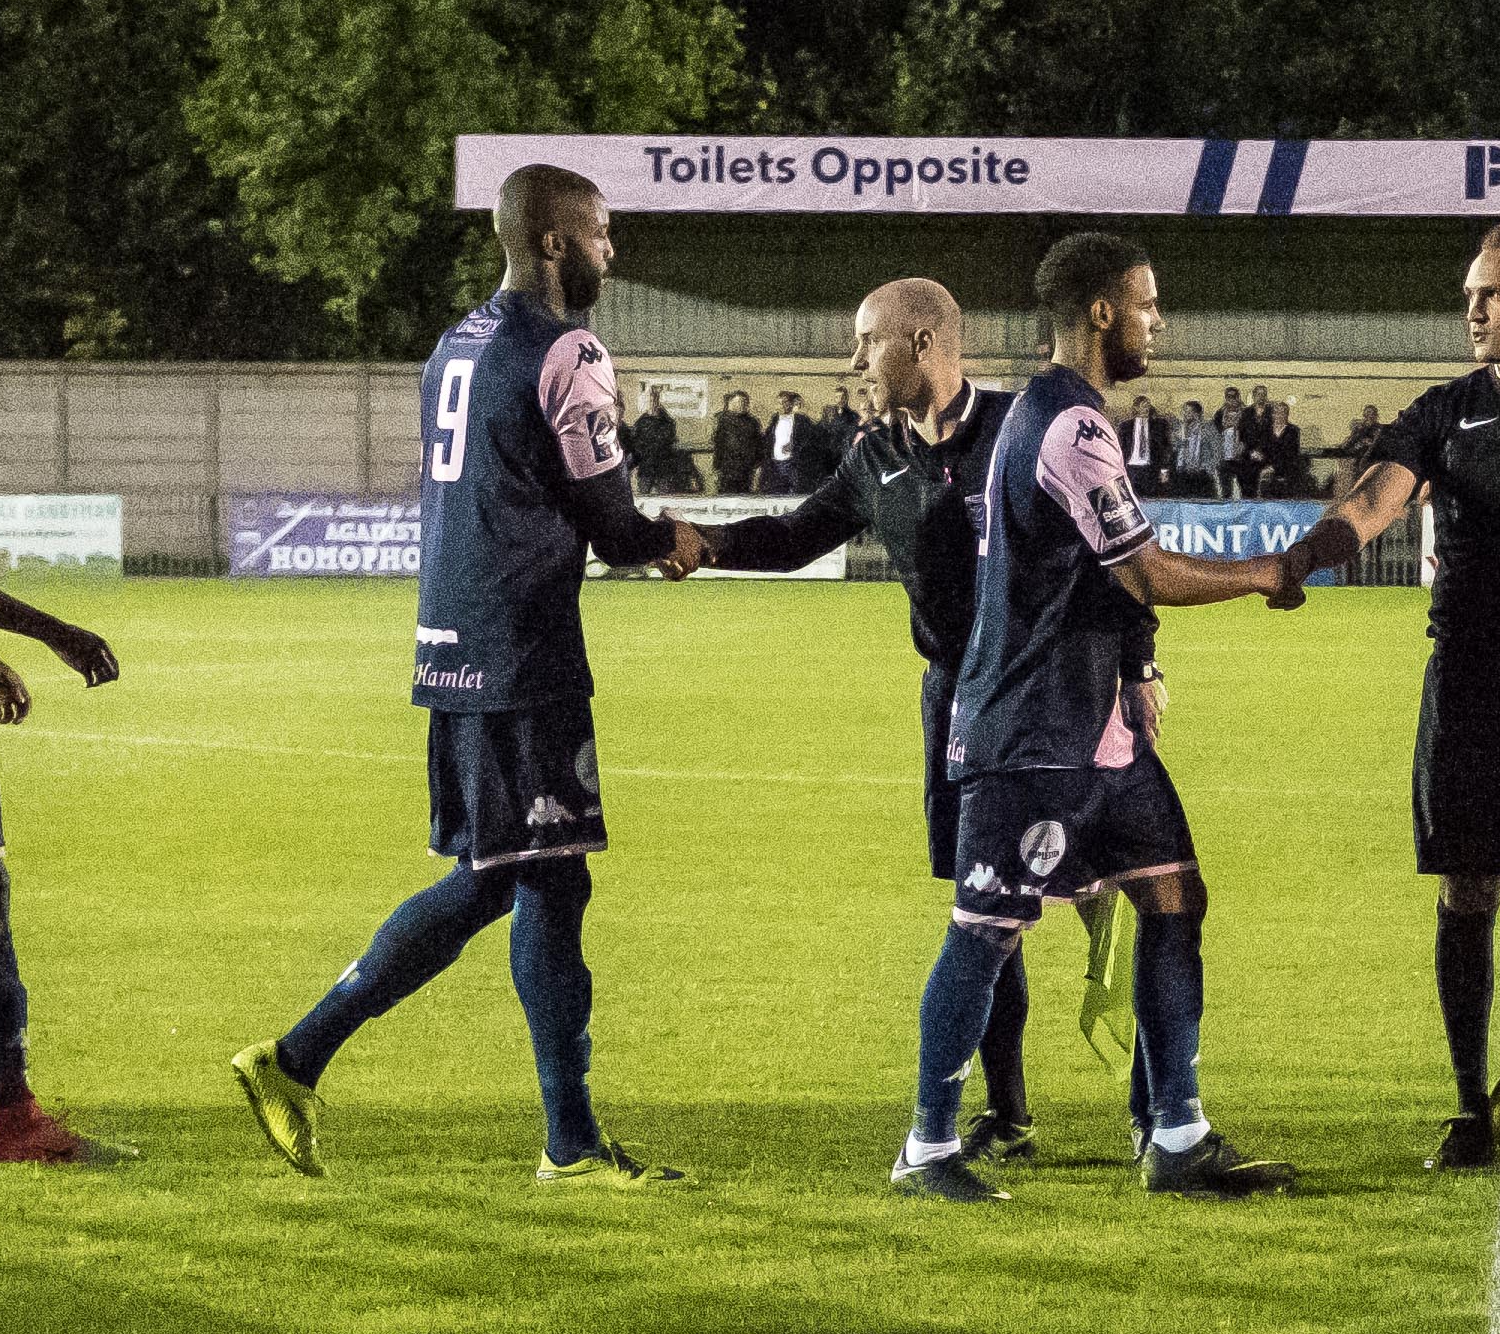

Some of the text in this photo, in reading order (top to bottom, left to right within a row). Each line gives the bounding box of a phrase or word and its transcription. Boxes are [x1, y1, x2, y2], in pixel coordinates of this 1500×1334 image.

[644, 146, 1030, 196] Toilets Opposite
[432, 358, 475, 482] 9
[416, 664, 484, 690] Hamlet
